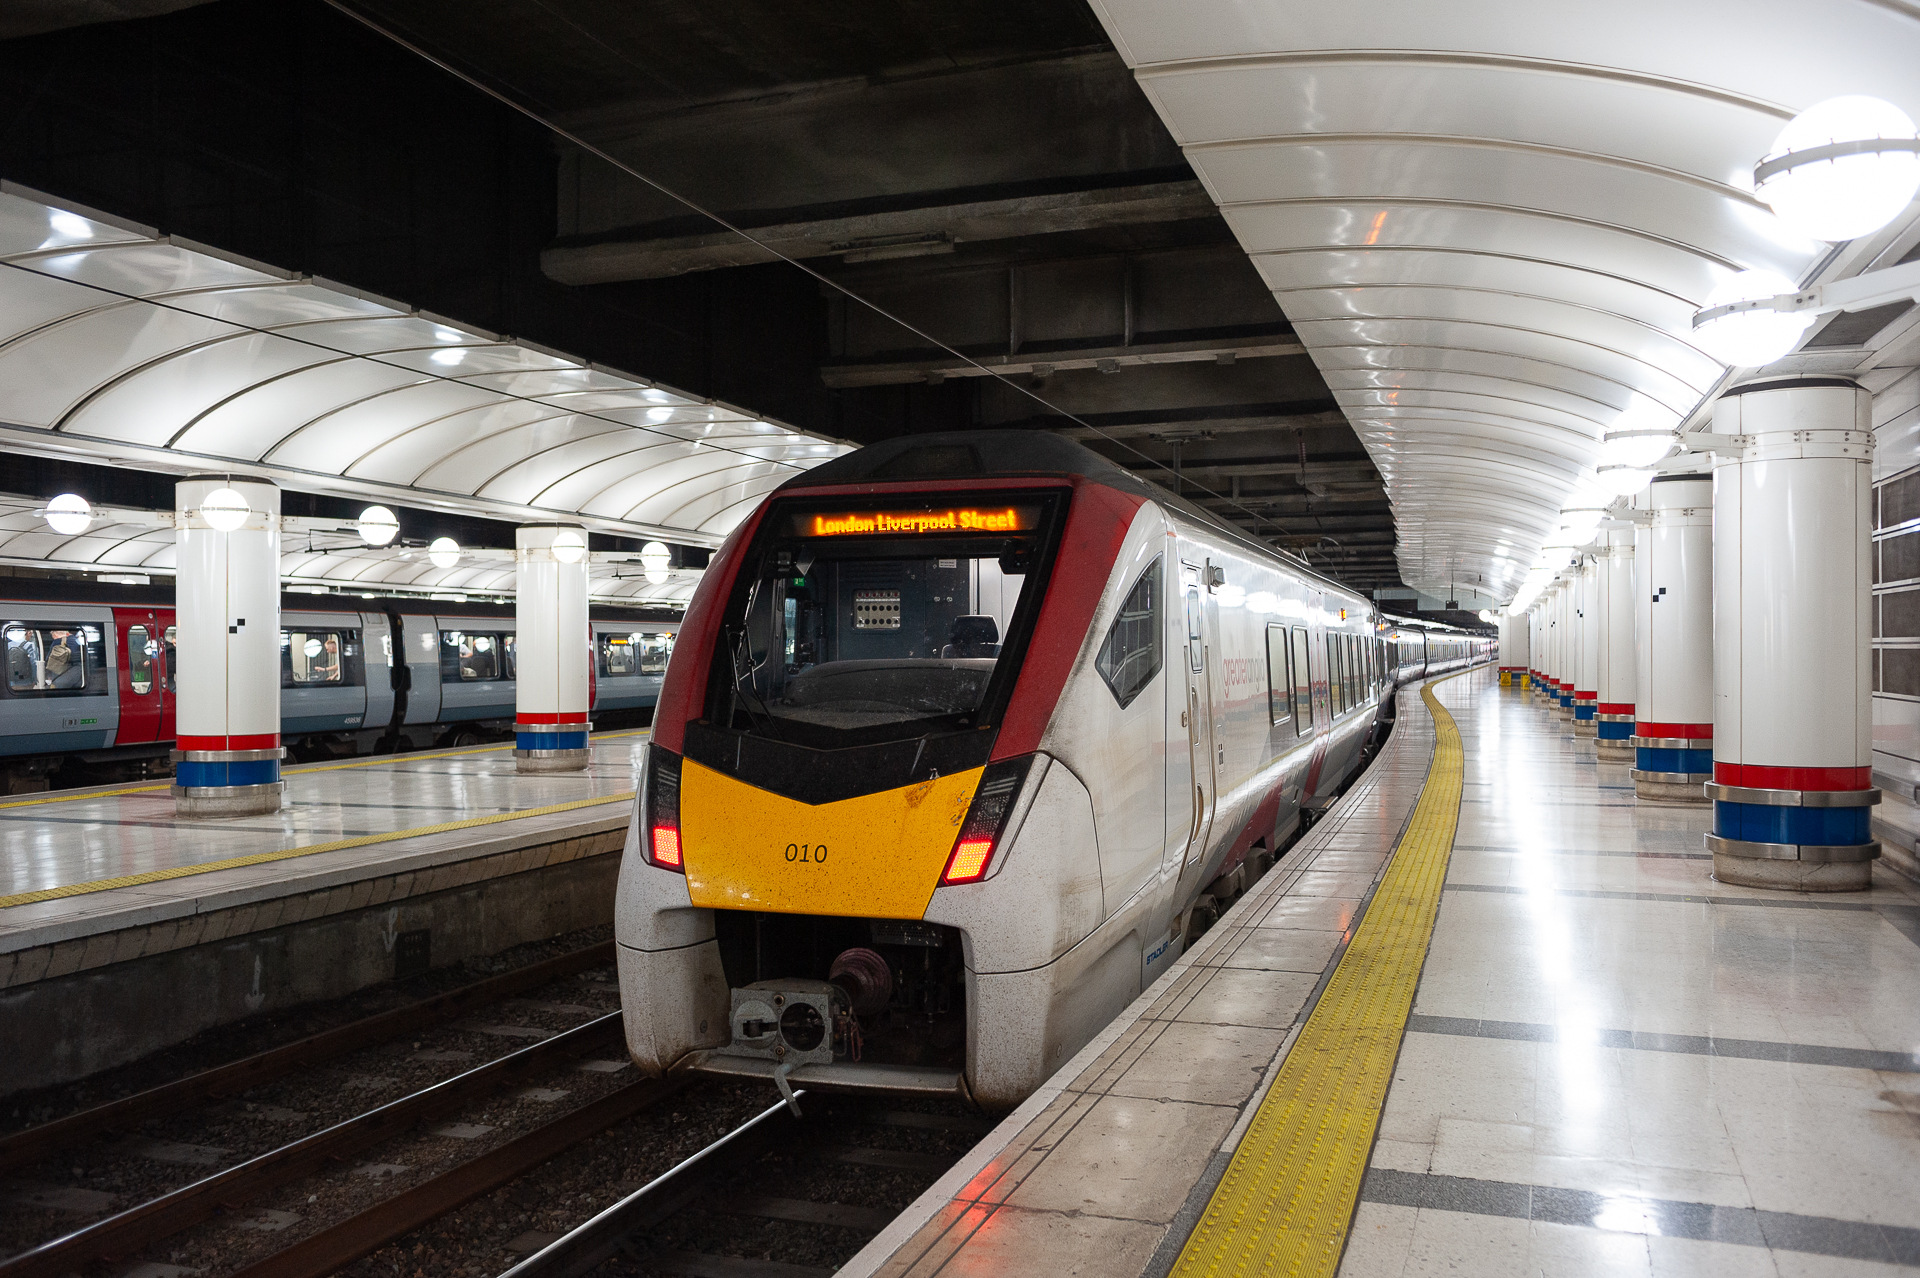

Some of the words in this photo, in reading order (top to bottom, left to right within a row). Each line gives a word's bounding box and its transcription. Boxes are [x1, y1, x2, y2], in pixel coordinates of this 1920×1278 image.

[816, 516, 873, 534] London
[877, 512, 956, 532] Liverpool
[959, 509, 1015, 528] Street
[785, 843, 828, 863] 010
[1146, 941, 1169, 966] STADLER
